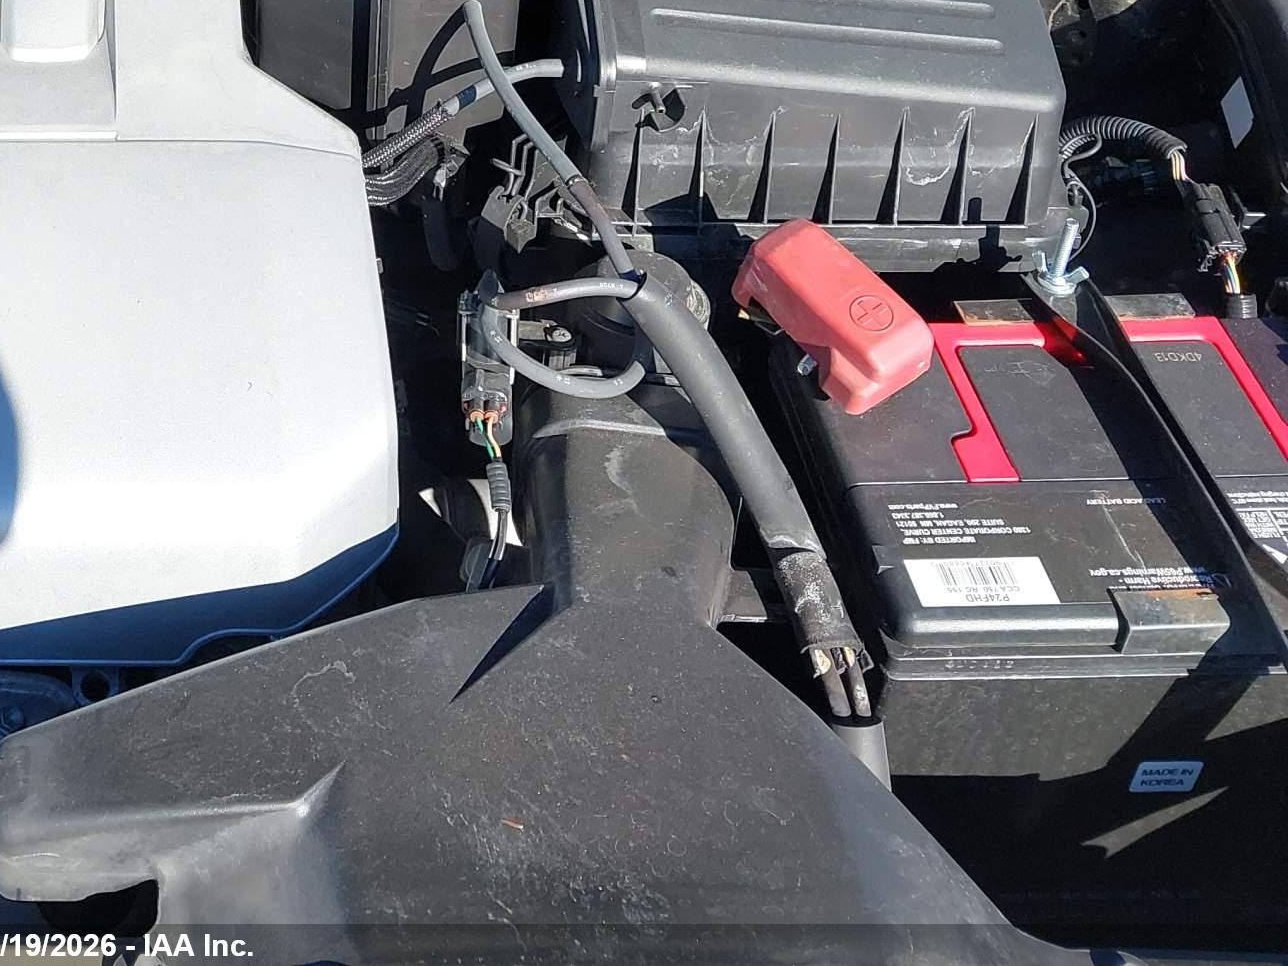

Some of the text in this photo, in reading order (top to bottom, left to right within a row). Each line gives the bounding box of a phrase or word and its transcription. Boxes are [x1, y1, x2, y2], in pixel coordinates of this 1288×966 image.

[1154, 352, 1202, 363] 4DKD13
[1086, 498, 1122, 506] BATTERY
[1143, 497, 1166, 505] LEAD
[981, 518, 1005, 526] SUITE
[930, 528, 963, 536] CENTER
[963, 527, 1012, 535] CORPORATE
[934, 535, 976, 544] IMPORTED
[1123, 576, 1151, 585] Harm
[999, 585, 1021, 593] CCA
[965, 593, 1010, 603] P24FHD
[1141, 768, 1179, 776] MADE
[1140, 778, 1184, 787] KOREA
